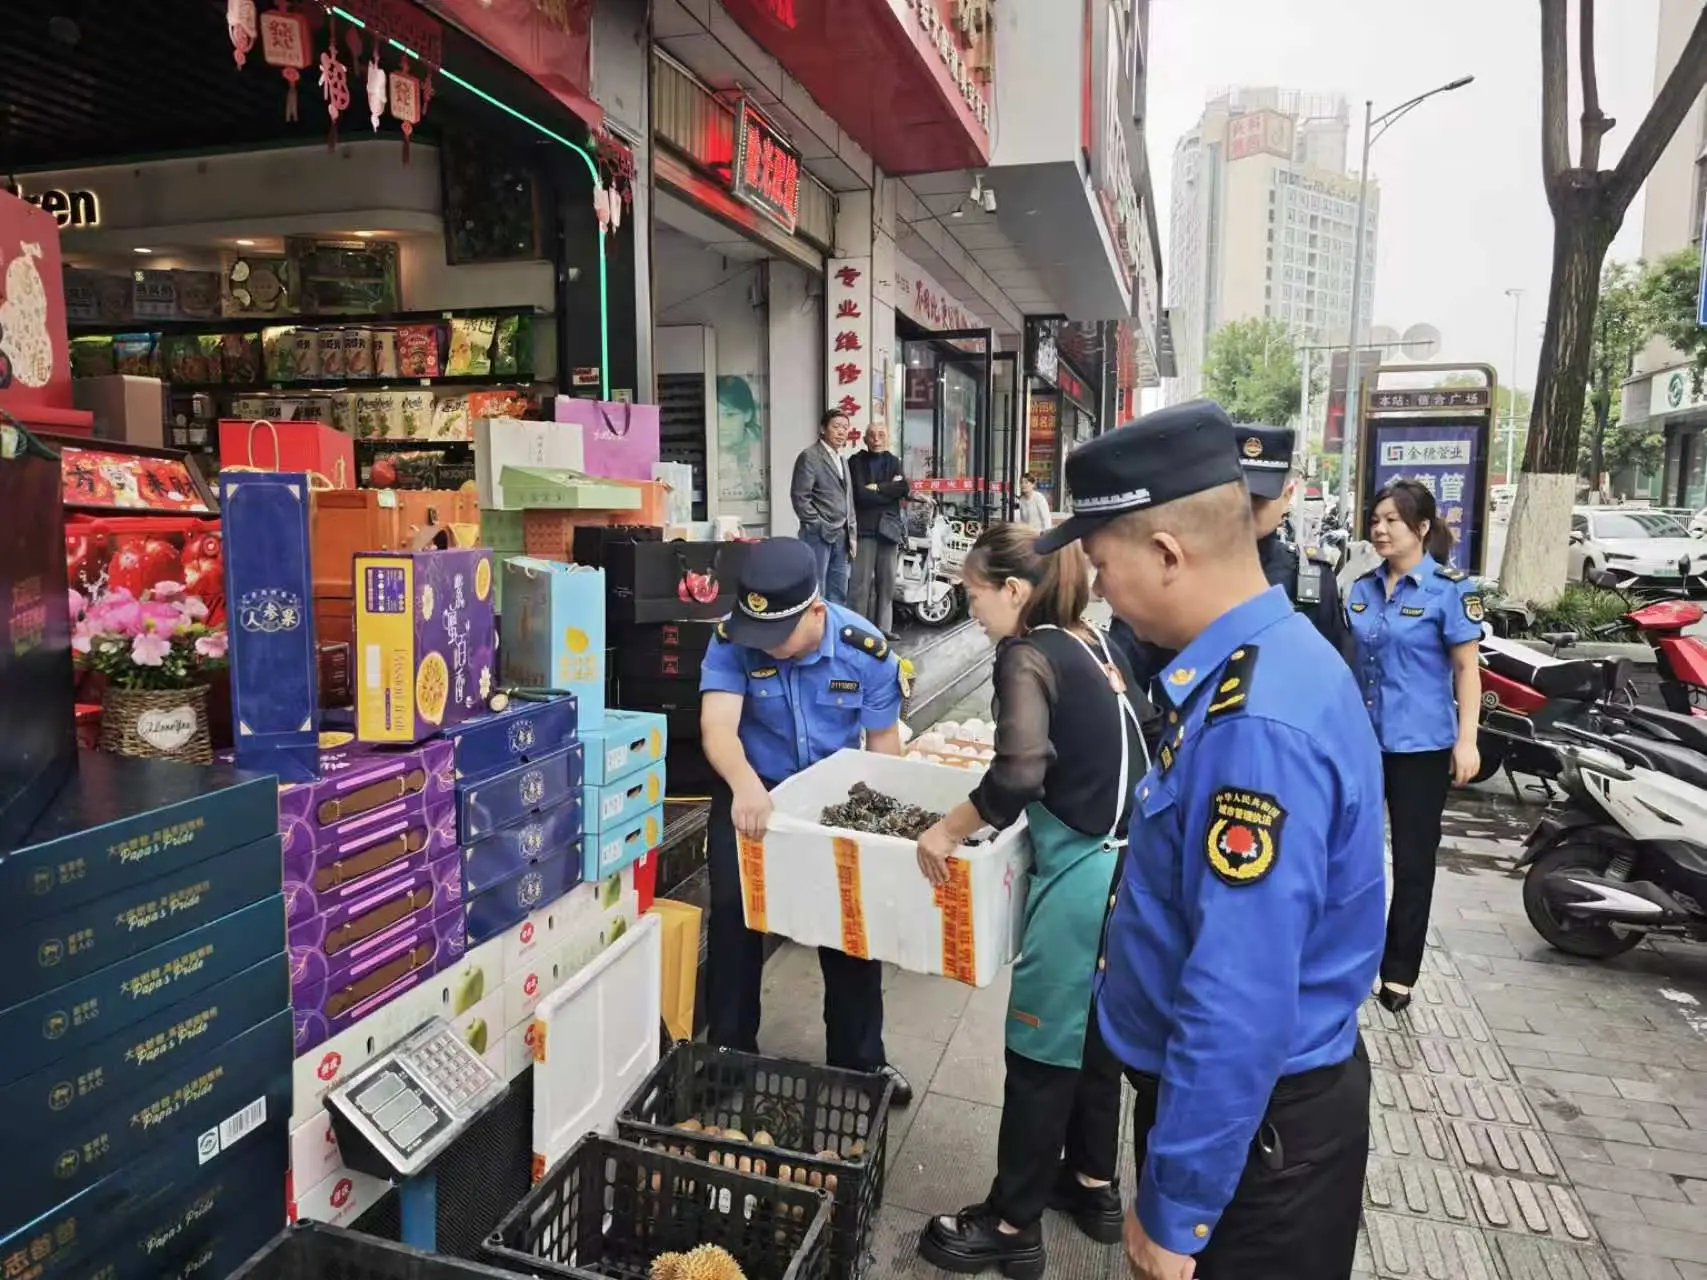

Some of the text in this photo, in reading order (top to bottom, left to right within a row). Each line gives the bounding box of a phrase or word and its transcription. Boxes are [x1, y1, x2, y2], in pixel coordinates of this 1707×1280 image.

[246, 602, 297, 628] 人参果
[0, 1215, 77, 1280] 志爸爸
